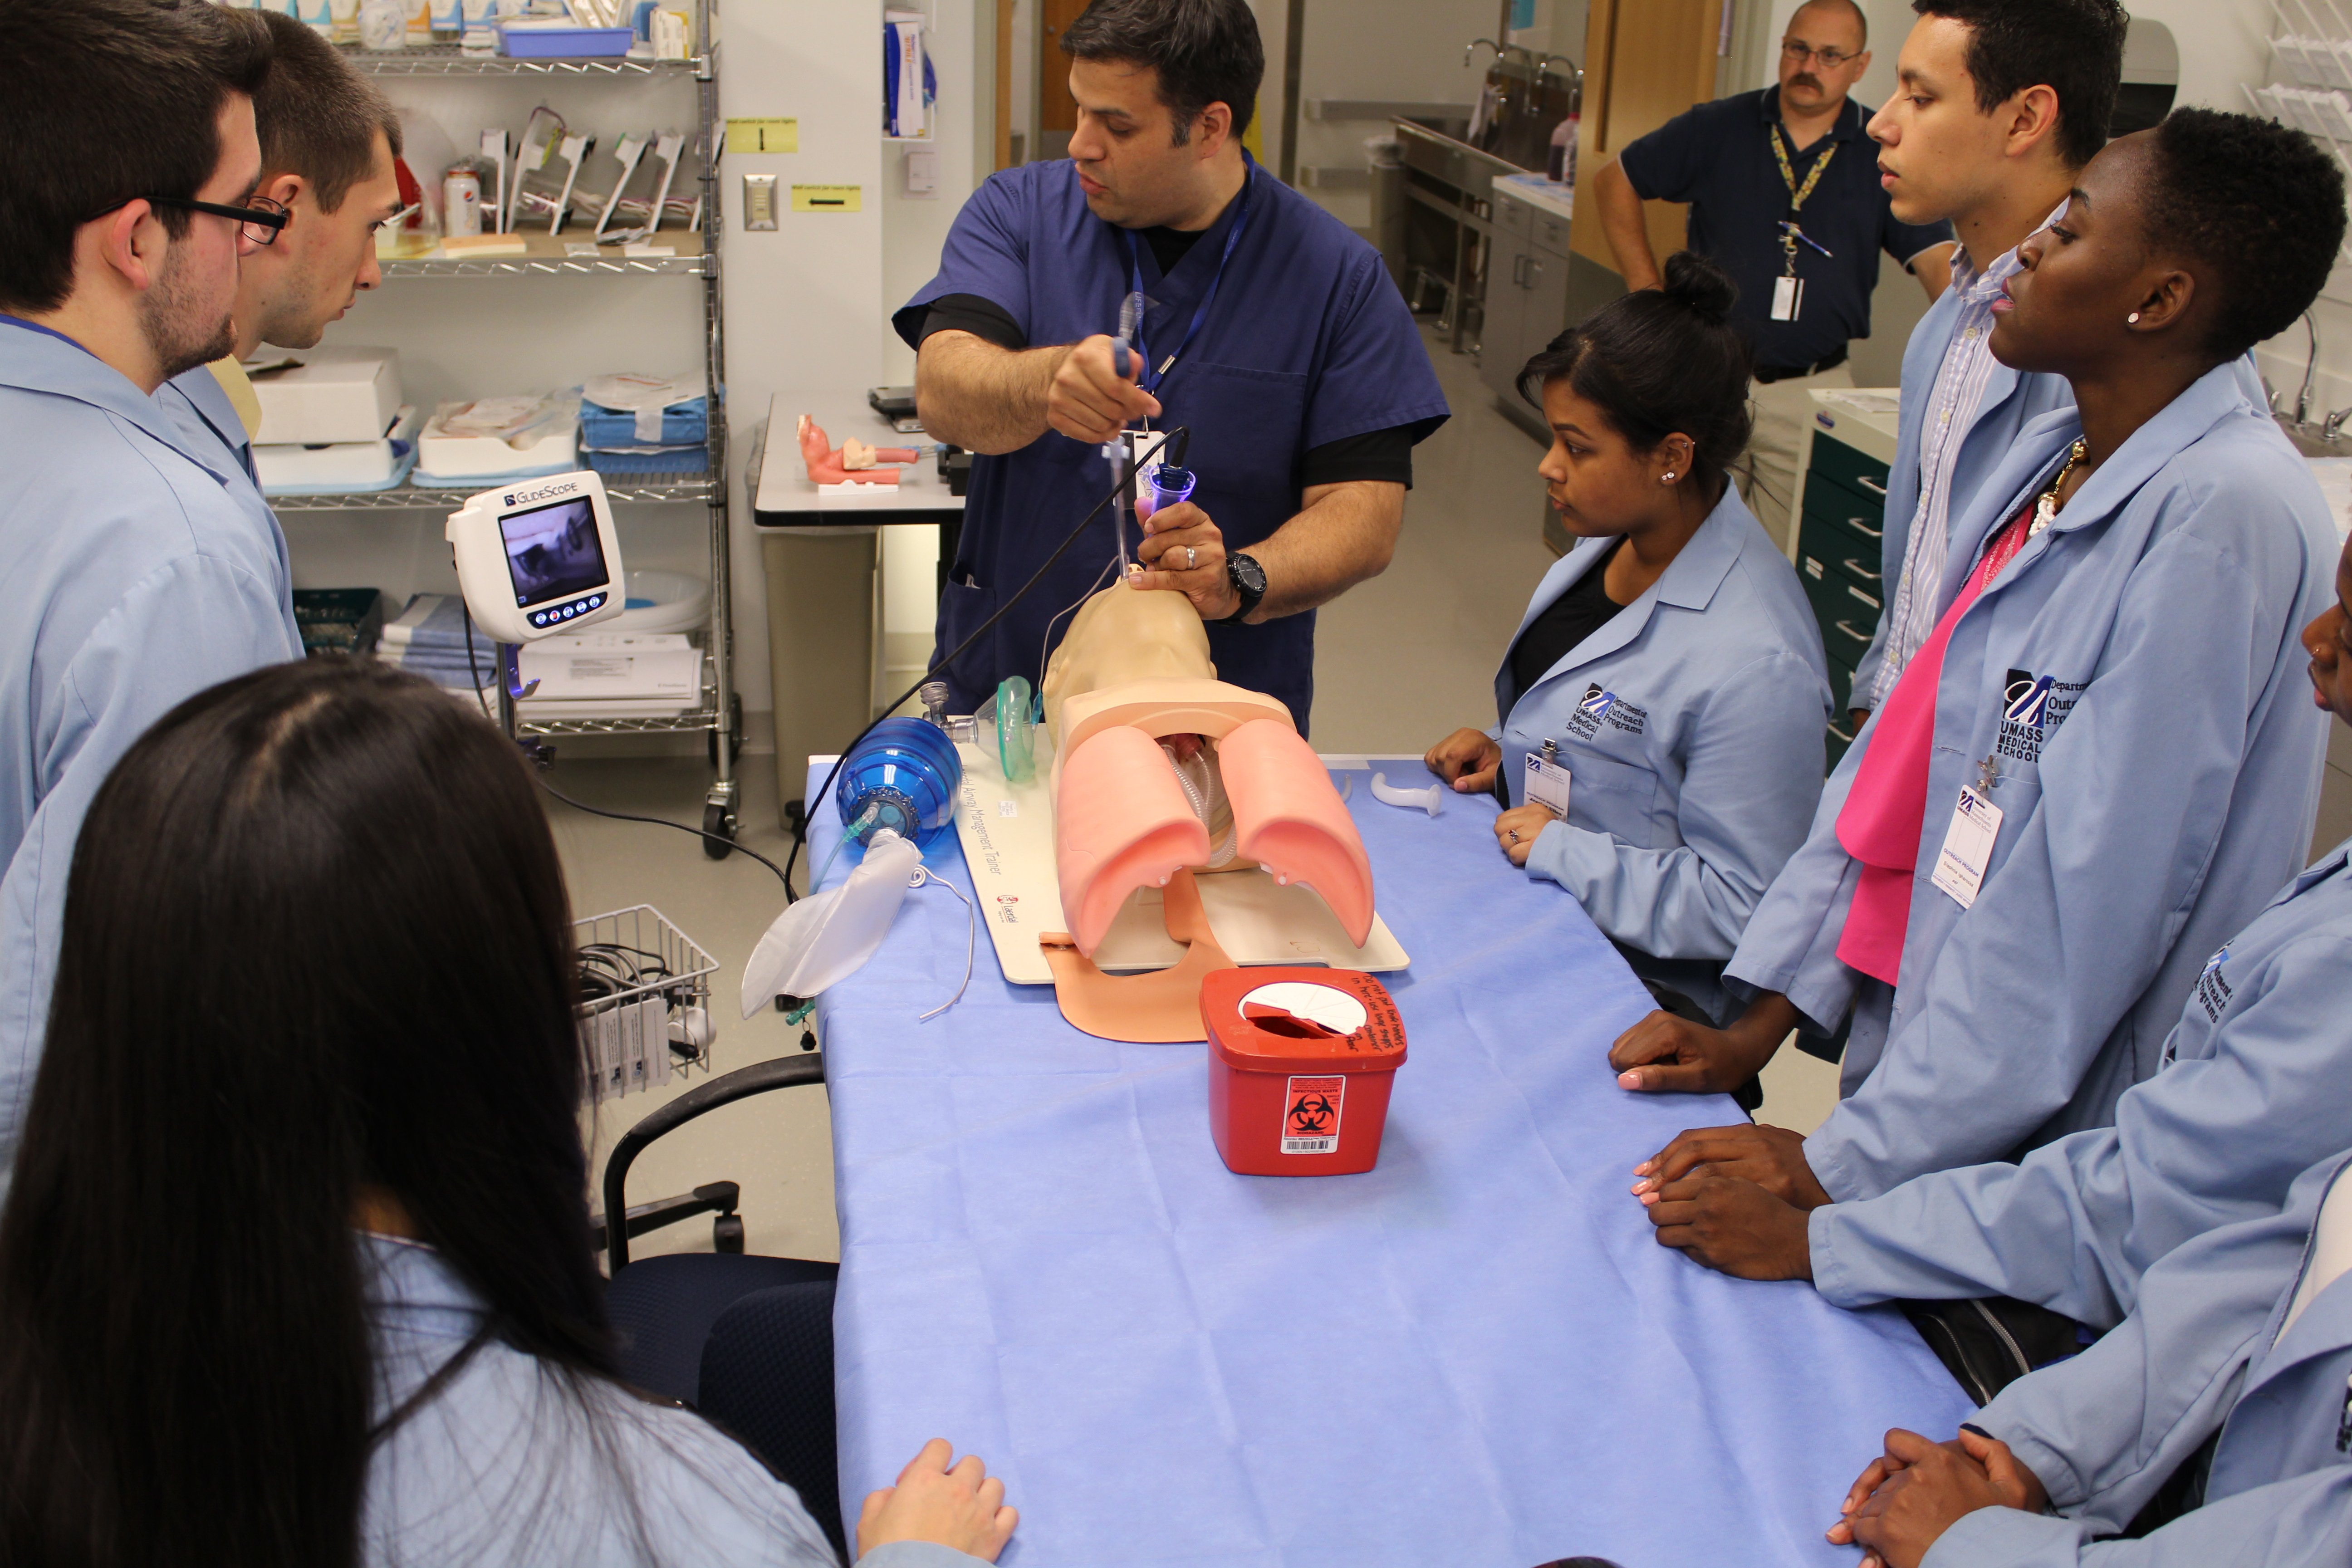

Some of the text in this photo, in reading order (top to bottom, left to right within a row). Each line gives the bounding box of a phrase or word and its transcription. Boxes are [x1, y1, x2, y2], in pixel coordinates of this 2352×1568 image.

[2051, 679, 2088, 693] Departm
[1570, 713, 1599, 734] Medical
[1603, 713, 1642, 735] Programs
[1608, 706, 1644, 727] Outreach
[2045, 711, 2066, 725] Pro
[1566, 722, 1594, 742] School
[2001, 720, 2043, 743] UMASS
[1997, 744, 2038, 763] SCHOOL
[1998, 734, 2042, 754] MEDICAL
[1546, 801, 1564, 811] PROGRAM
[1957, 806, 1969, 817] UMASS
[961, 787, 978, 808] Airway
[970, 809, 993, 850] Management
[985, 851, 1001, 875] Trainer
[1943, 848, 1979, 877] OUTREACH PROGRAM
[1004, 905, 1019, 923] Laerdal
[1371, 984, 1386, 995] not
[1376, 997, 1393, 1006] put
[1364, 1024, 1383, 1052] container
